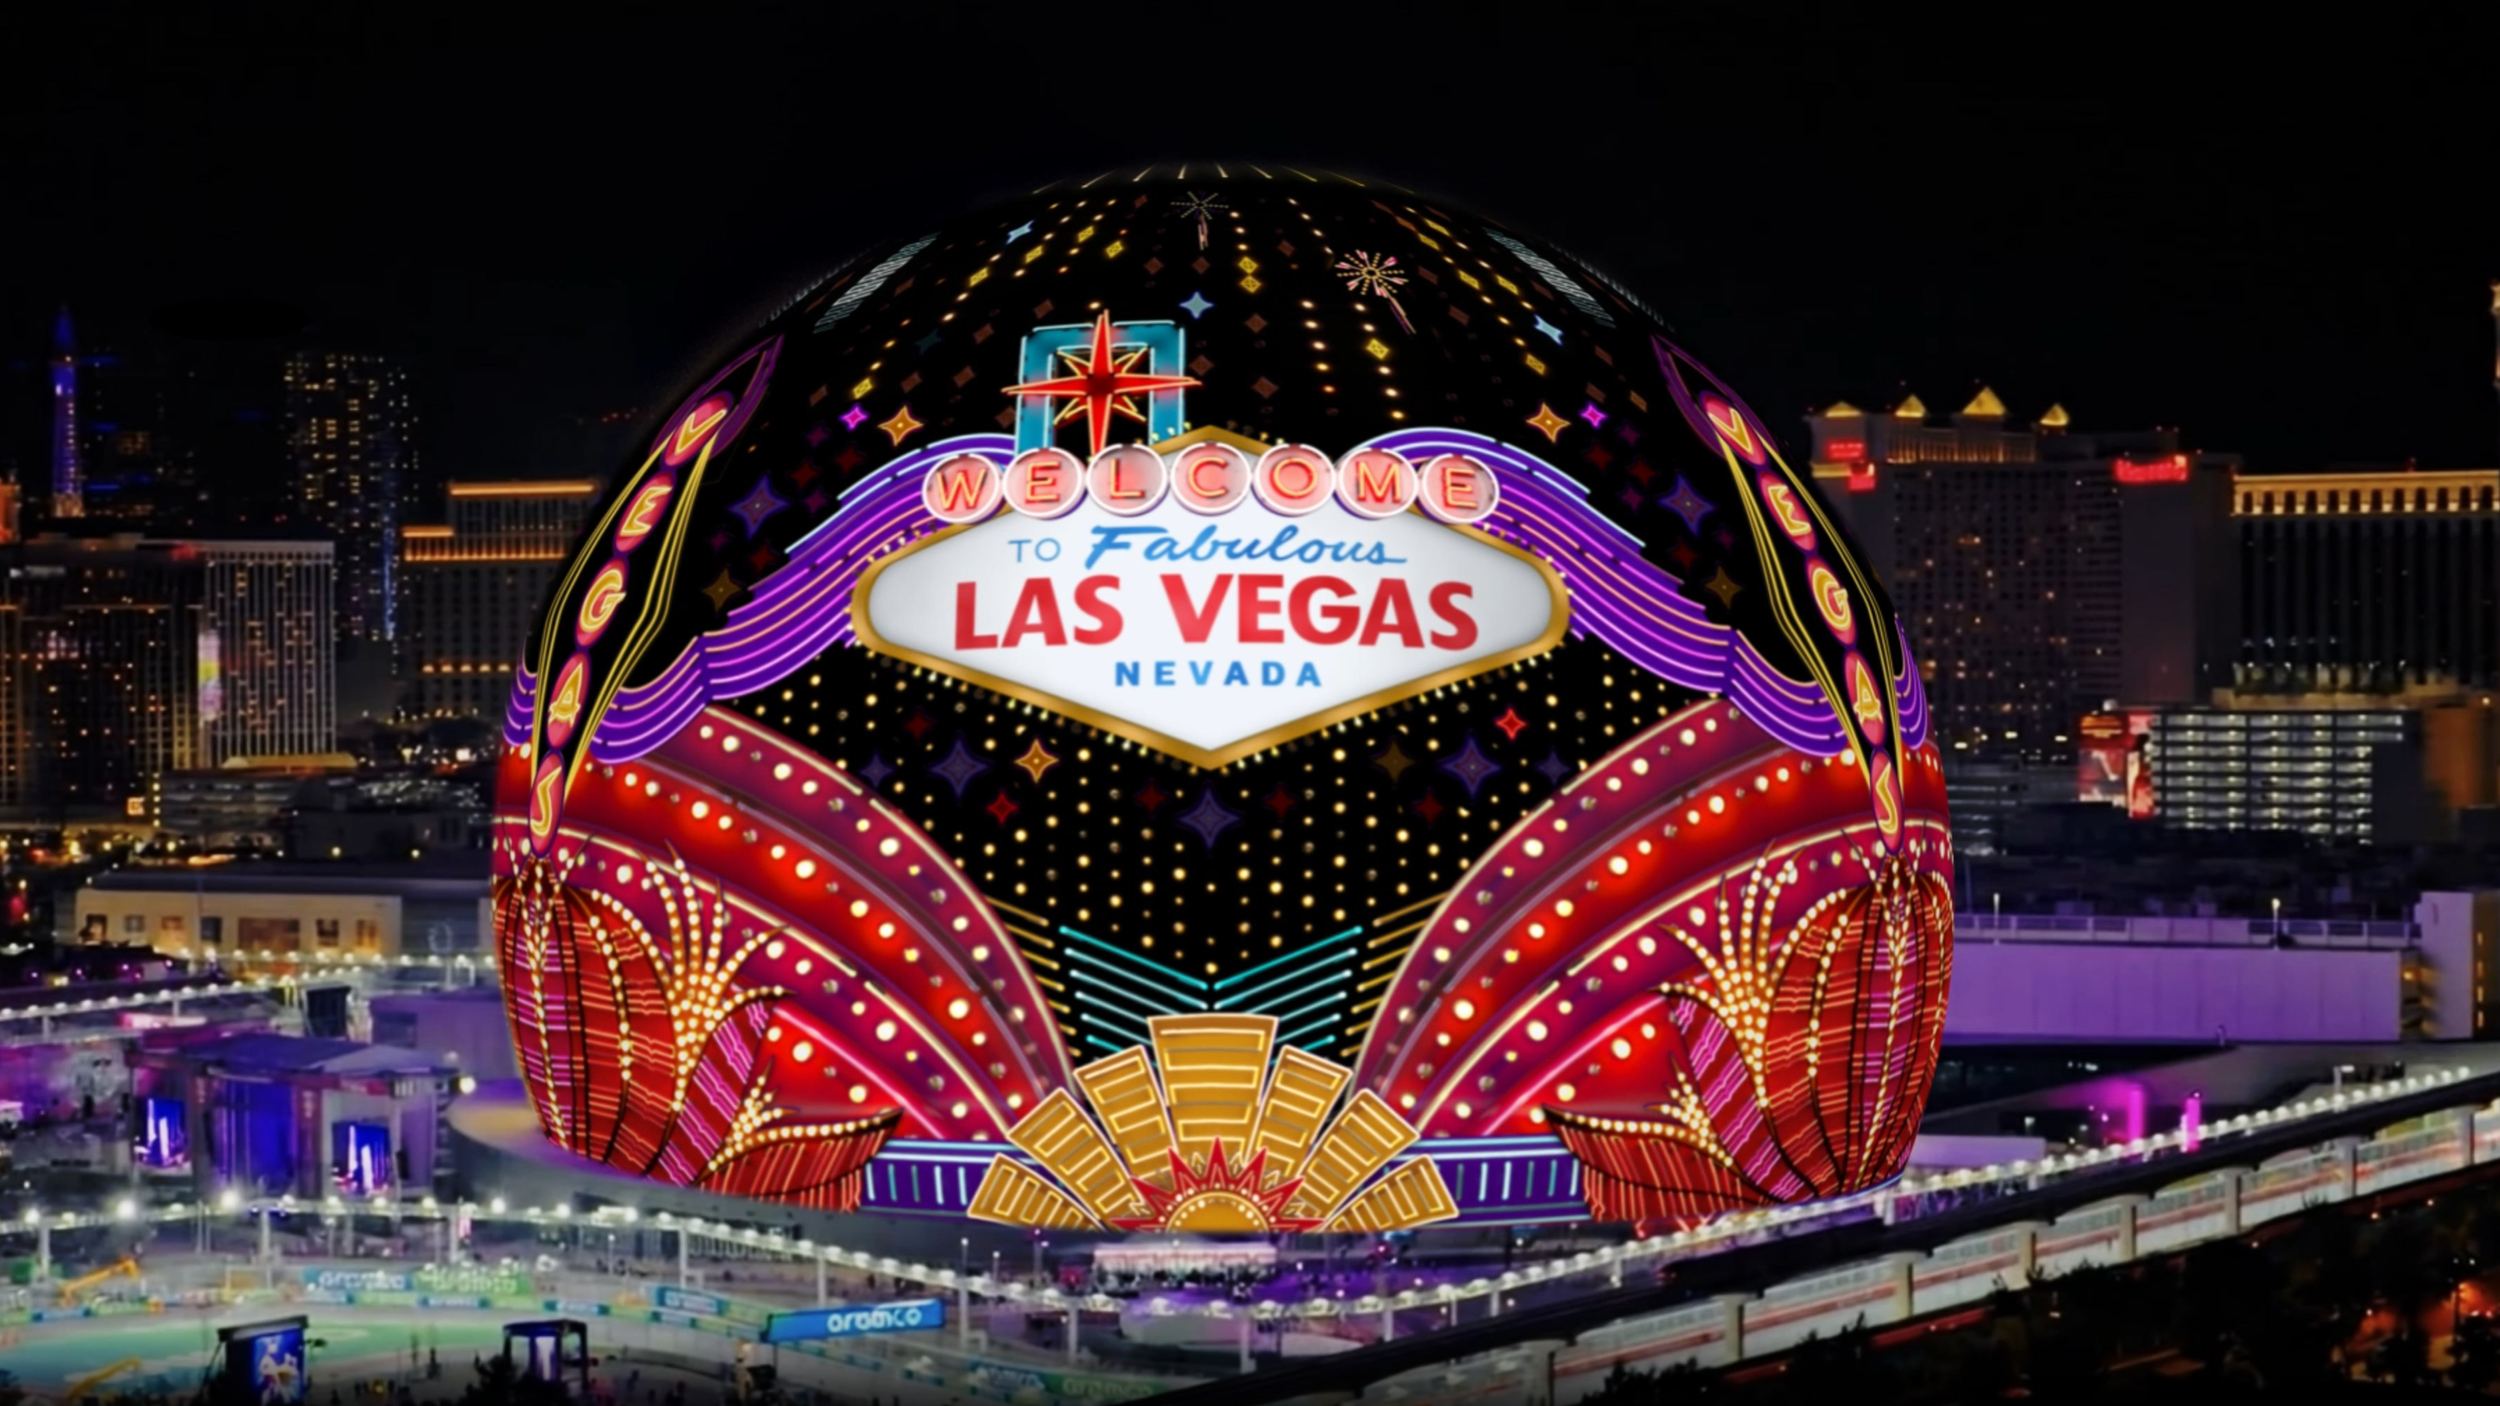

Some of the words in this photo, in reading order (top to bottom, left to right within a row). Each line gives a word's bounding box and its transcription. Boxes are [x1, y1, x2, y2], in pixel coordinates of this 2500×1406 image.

[936, 456, 1478, 511] WELCOME
[1007, 537, 1061, 563] TO
[1084, 523, 1408, 570] Fabulous
[530, 408, 727, 837] VEGAS
[953, 573, 1125, 651] LAS
[1159, 573, 1480, 651] VEGAS
[1707, 407, 1898, 835] VEGAS
[1115, 661, 1322, 687] NEVADA
[827, 1308, 922, 1333] aramco
